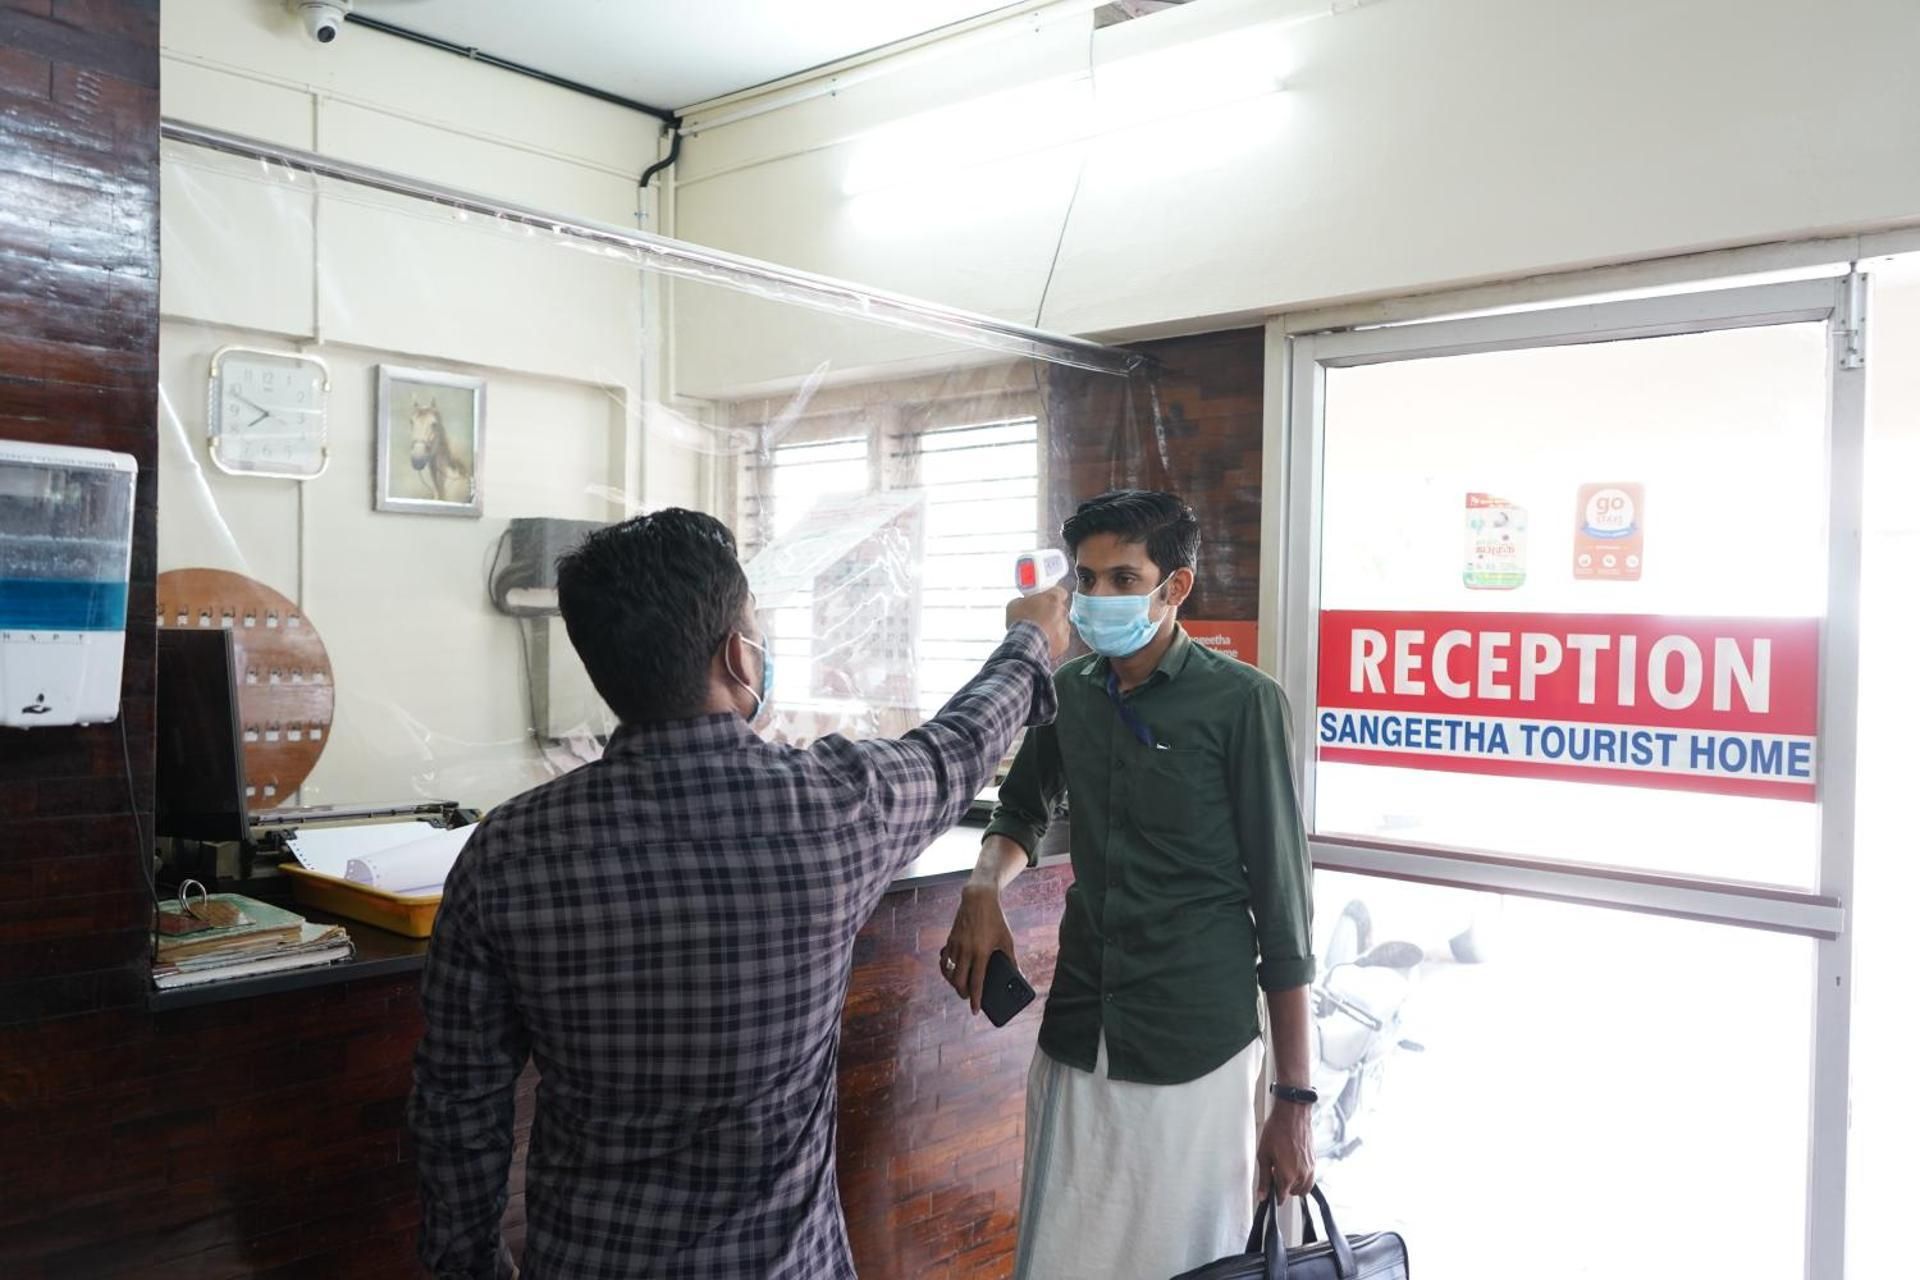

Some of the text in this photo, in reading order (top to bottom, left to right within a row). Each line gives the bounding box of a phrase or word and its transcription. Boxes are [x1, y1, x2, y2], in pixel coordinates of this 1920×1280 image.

[263, 371, 273, 385] 12
[1596, 496, 1625, 515] go
[1350, 628, 1771, 713] RECEPTION
[1320, 712, 1811, 777] SANGEETHA TOURIST HOME
